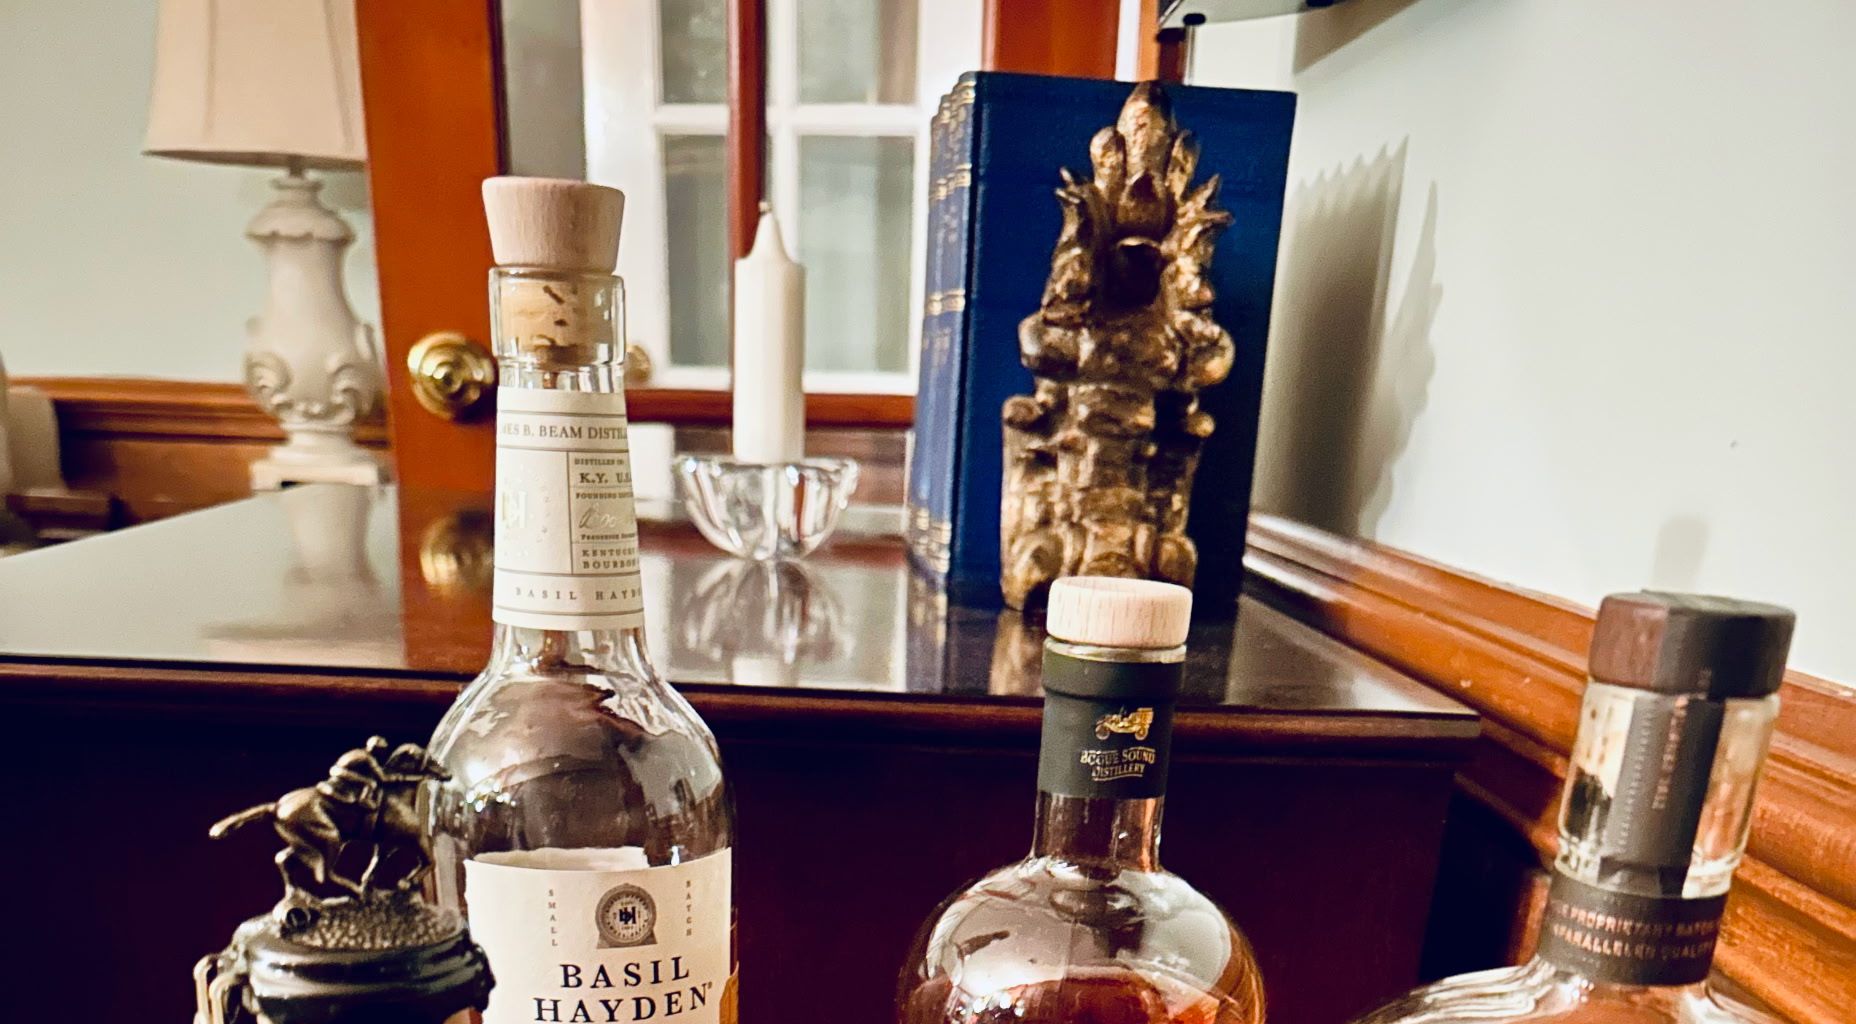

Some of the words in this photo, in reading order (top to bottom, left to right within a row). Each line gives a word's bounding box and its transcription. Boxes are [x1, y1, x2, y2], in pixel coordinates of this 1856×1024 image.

[539, 425, 582, 439] BEAM
[579, 472, 608, 483] K.Y.
[515, 587, 577, 600] BASIL
[1122, 747, 1156, 764] SOUND
[1092, 764, 1145, 778] DISTILLERY
[559, 956, 689, 989] BASIL
